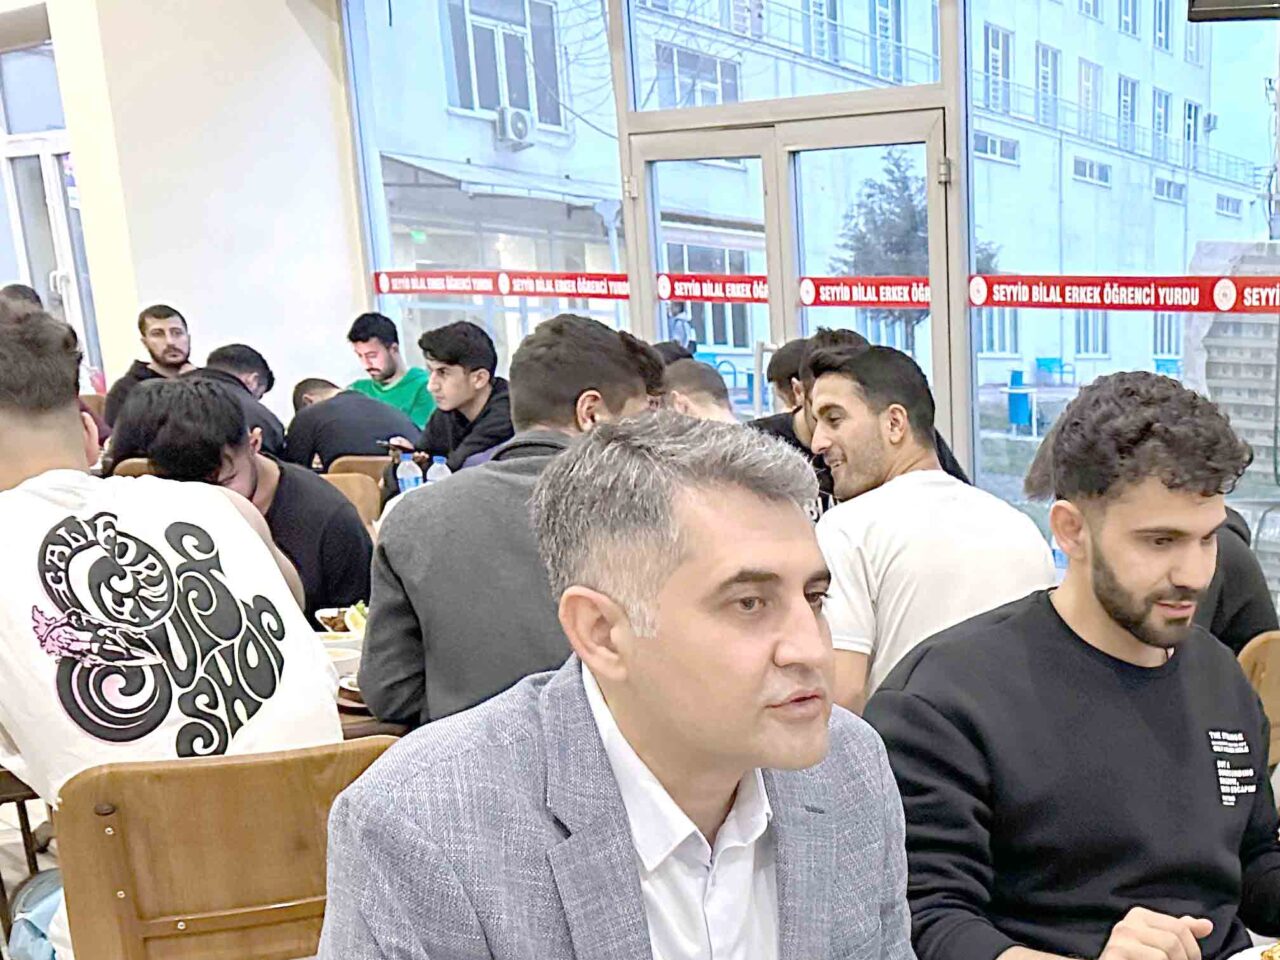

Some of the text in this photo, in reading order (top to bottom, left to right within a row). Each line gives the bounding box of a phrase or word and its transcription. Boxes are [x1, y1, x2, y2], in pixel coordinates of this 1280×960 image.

[674, 279, 701, 297] SEYYİD
[702, 280, 725, 297] BİLAL
[725, 282, 753, 299] ERKEK
[819, 282, 850, 302] SEYYİD
[851, 282, 879, 302] BİLAL
[879, 285, 910, 302] ERKEK
[992, 281, 1200, 306] SEYYİD BİLAL ERKEK ÖĞRENCİ YURDU
[176, 594, 286, 758] SHOP
